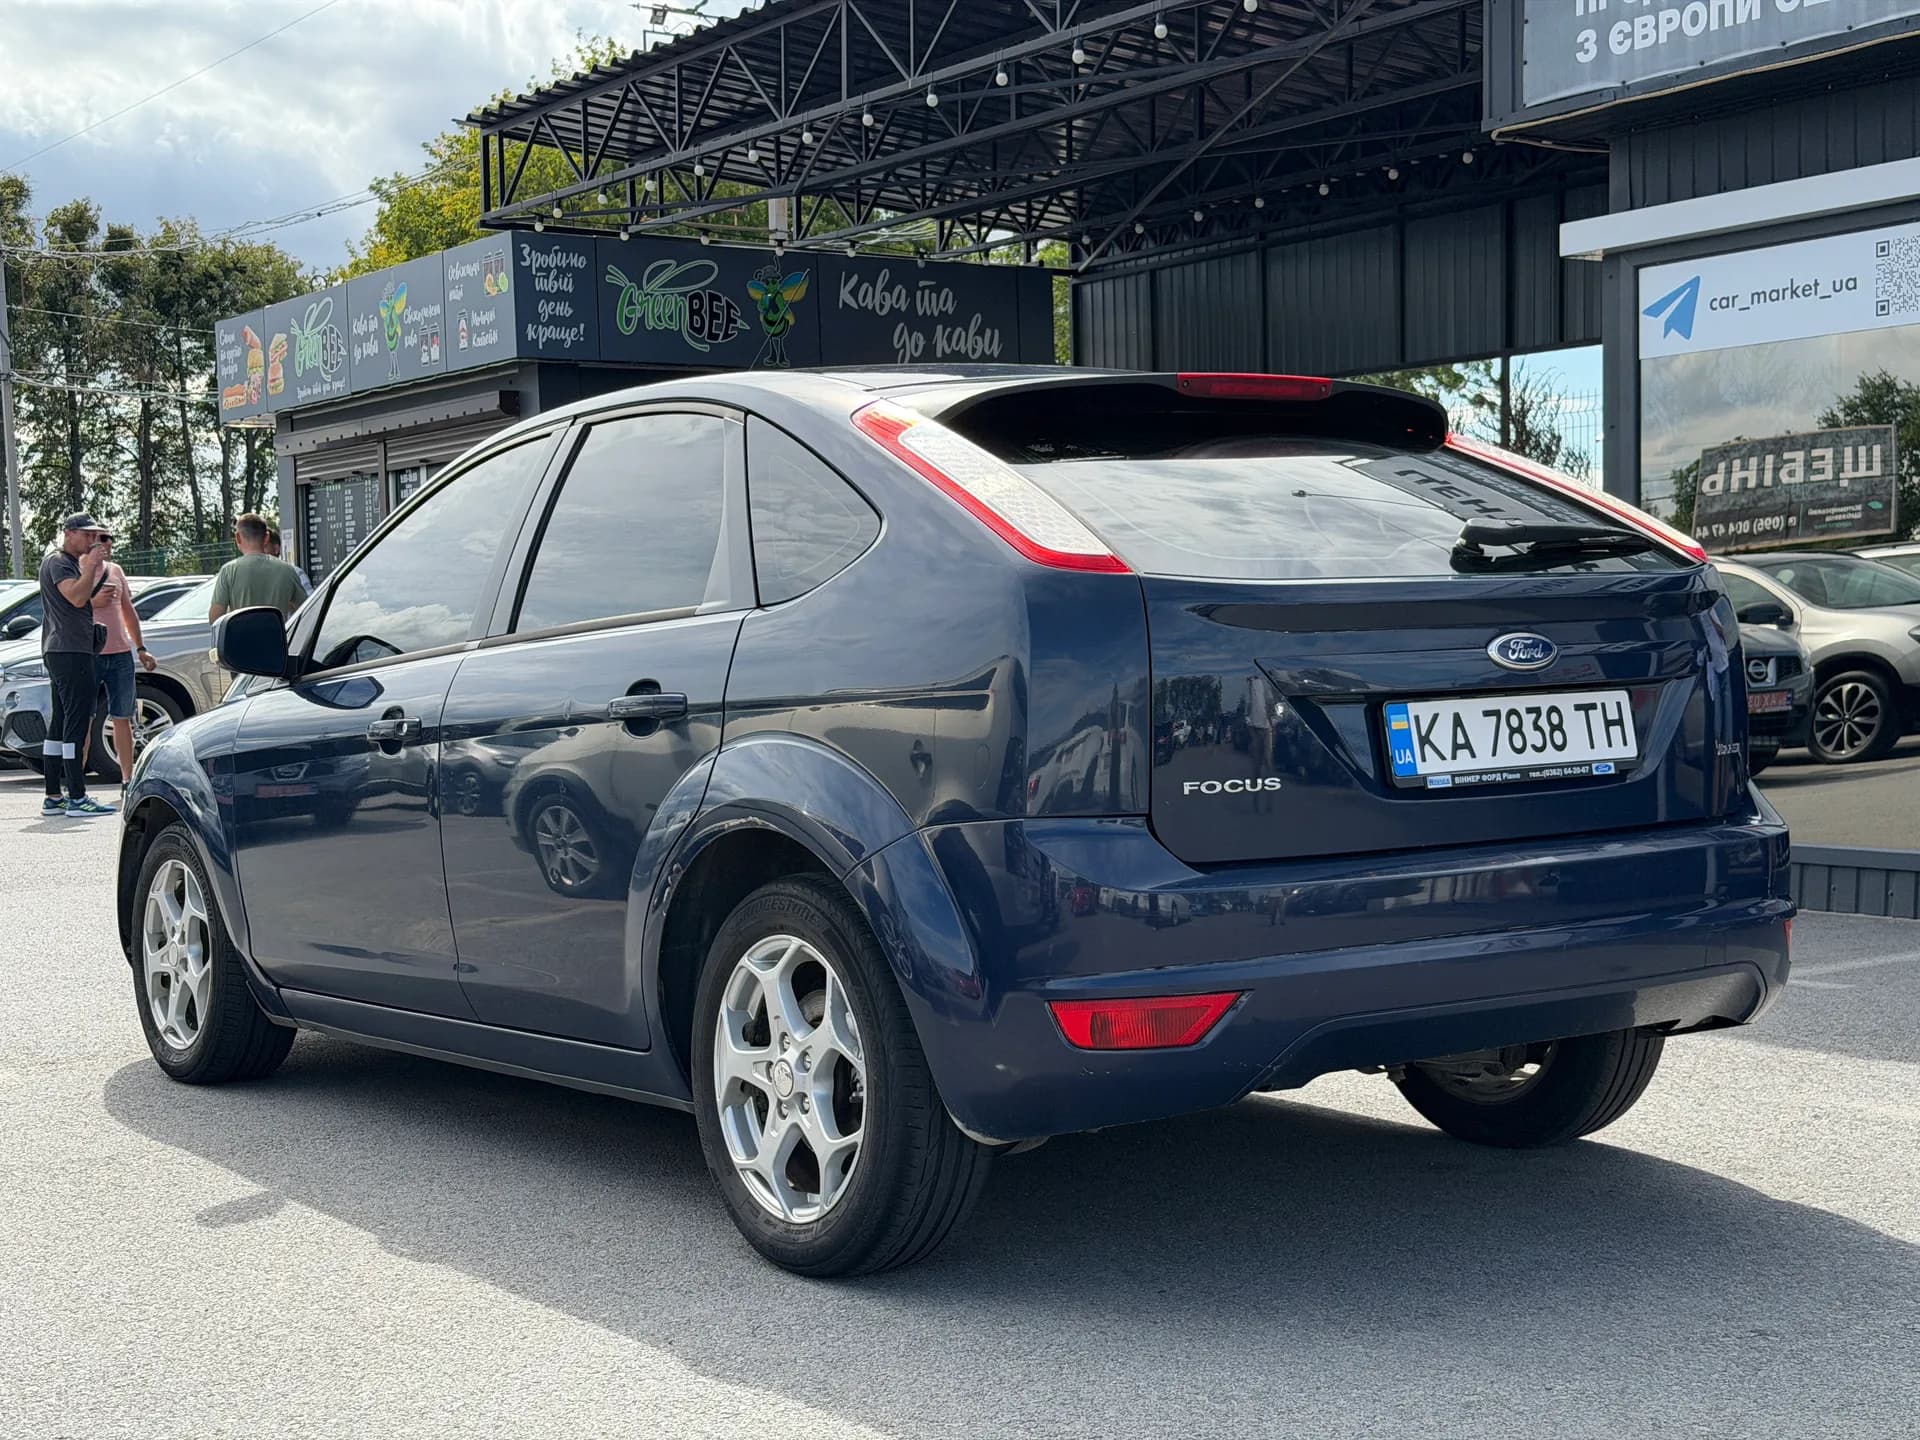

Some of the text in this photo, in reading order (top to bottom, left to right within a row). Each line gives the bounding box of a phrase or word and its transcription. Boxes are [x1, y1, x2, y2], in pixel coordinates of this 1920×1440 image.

[1575, 0, 1761, 63] З ЄВРОПИ
[520, 243, 587, 275] Зробимо
[535, 268, 575, 294] твій
[838, 268, 958, 317] Кава та
[1709, 276, 1858, 311] car_market_ua
[537, 299, 574, 323] день
[525, 323, 585, 350] краще!
[892, 313, 1003, 364] до кави
[1508, 638, 1544, 660] Ford
[1414, 701, 1628, 763] KA 7838 TH
[1395, 749, 1415, 765] UA
[1183, 777, 1282, 795] FOCUS
